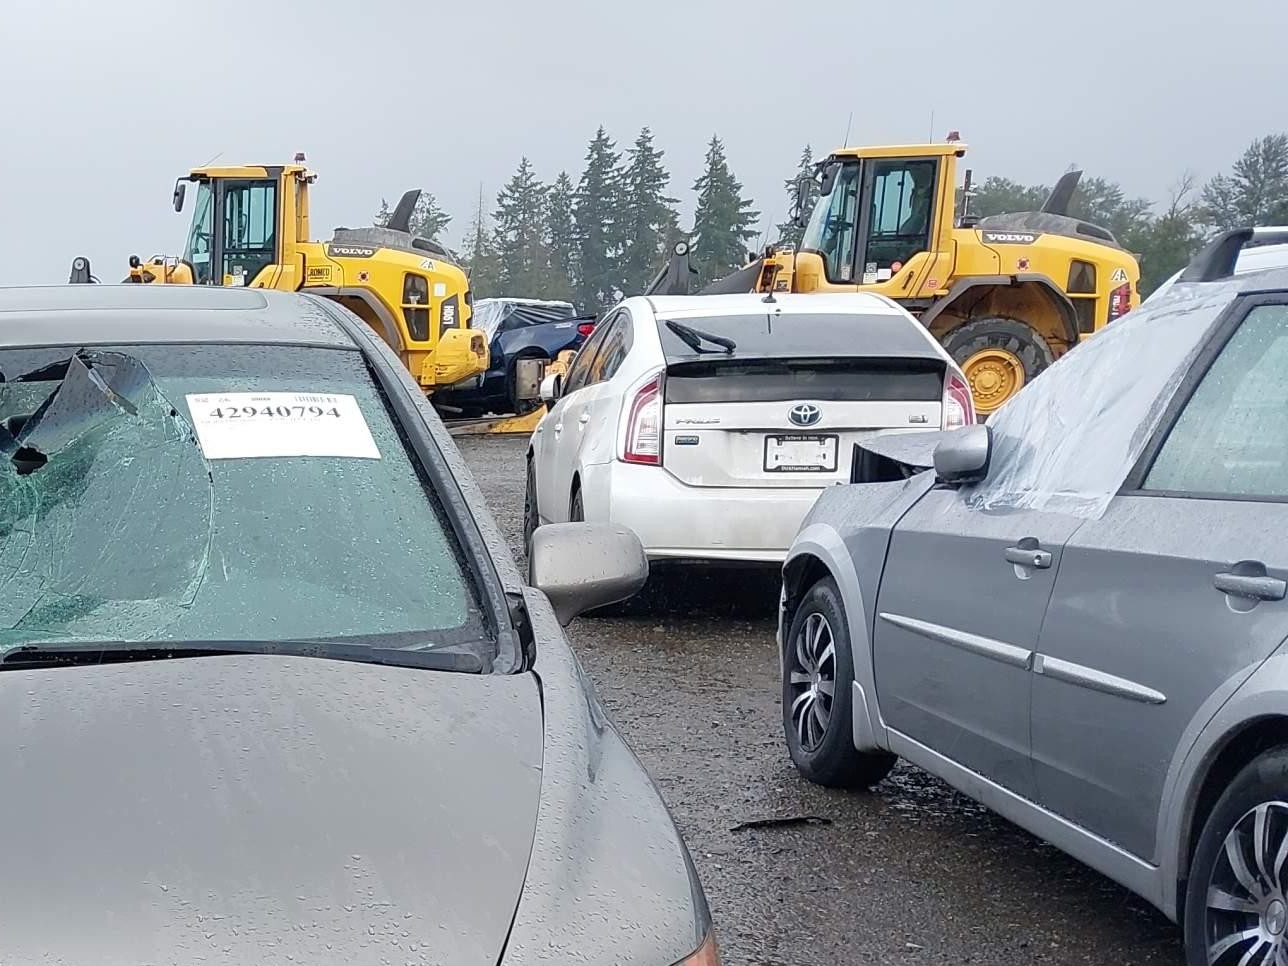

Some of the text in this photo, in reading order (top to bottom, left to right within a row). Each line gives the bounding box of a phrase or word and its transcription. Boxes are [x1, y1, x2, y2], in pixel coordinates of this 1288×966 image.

[986, 233, 1034, 242] VOLVO
[333, 247, 373, 256] VOLVO
[443, 305, 455, 325] L90H
[209, 406, 341, 418] 42940794
